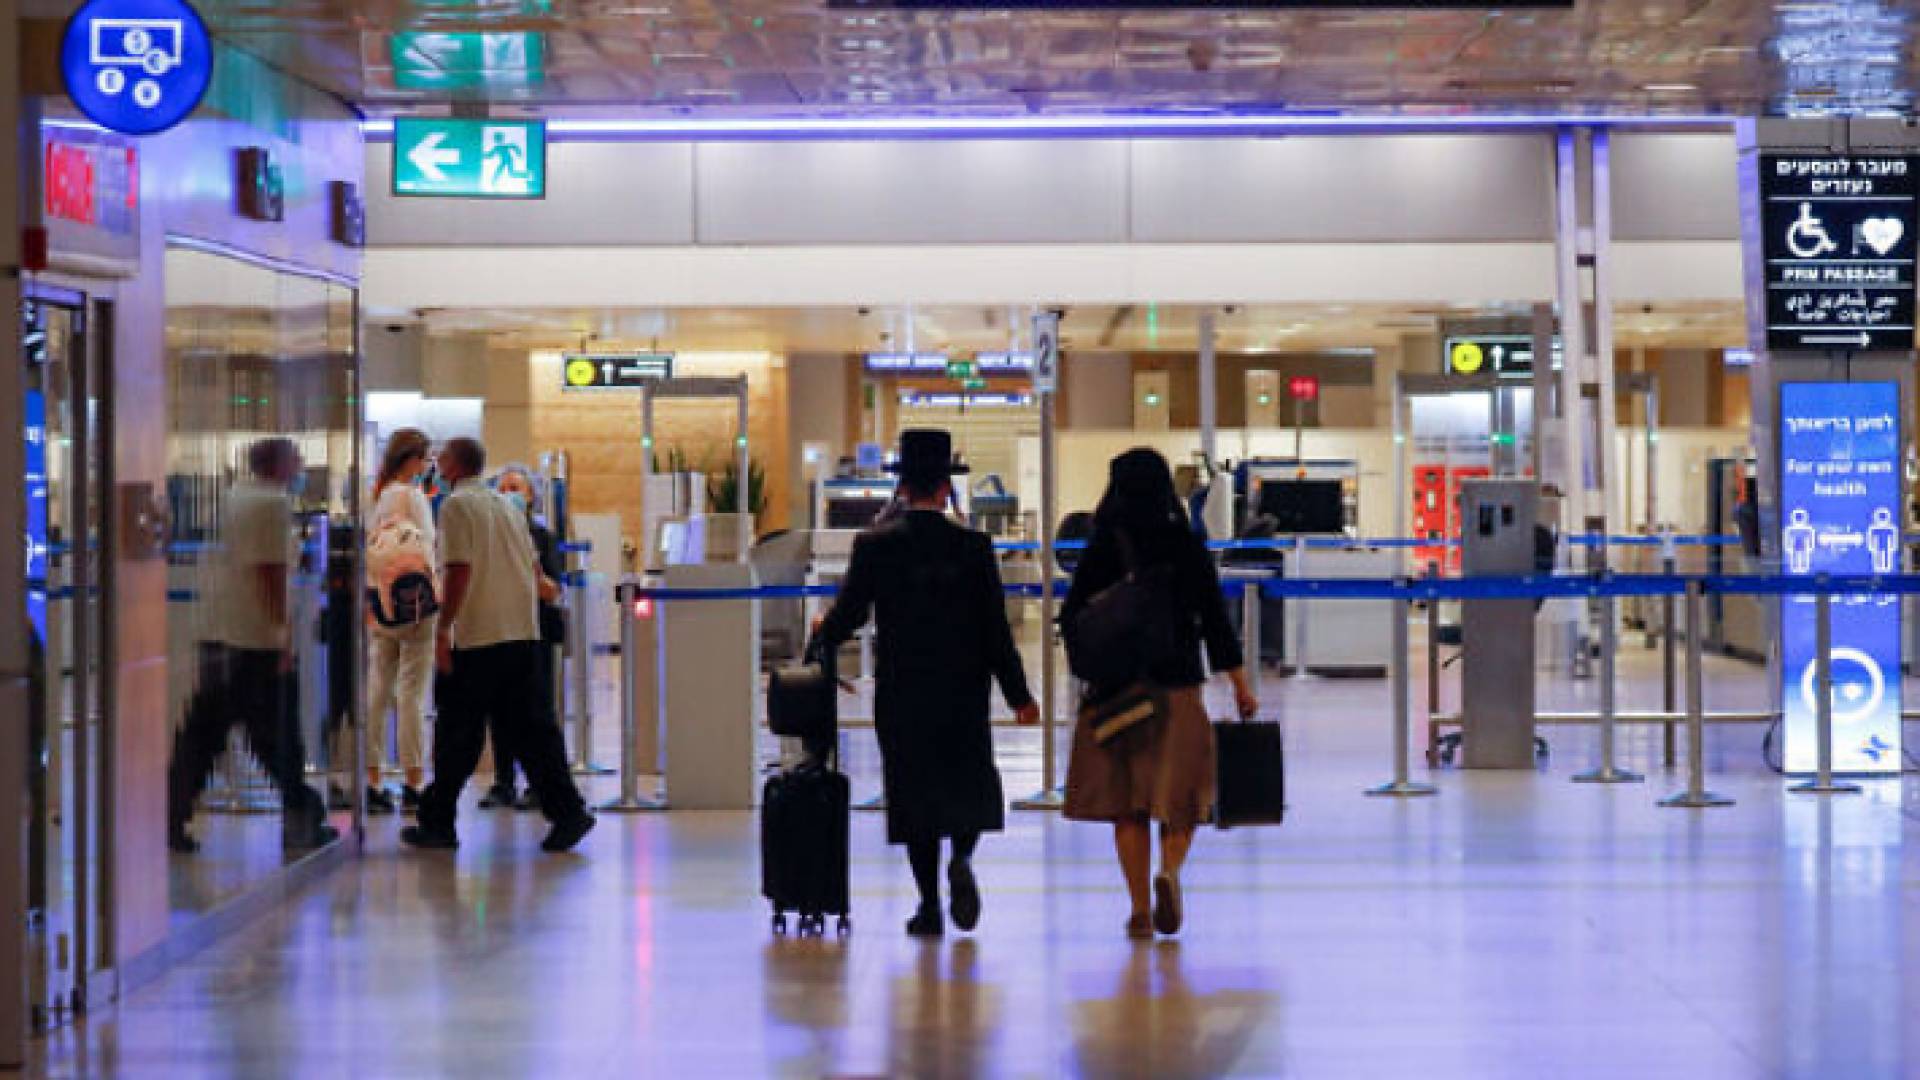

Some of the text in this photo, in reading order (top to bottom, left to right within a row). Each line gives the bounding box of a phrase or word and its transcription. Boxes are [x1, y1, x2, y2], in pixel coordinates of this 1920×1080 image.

[1856, 159, 1907, 176] מעבר
[1038, 332, 1051, 377] 2
[1785, 458, 1892, 476] For your own
[1813, 479, 1867, 496] health
